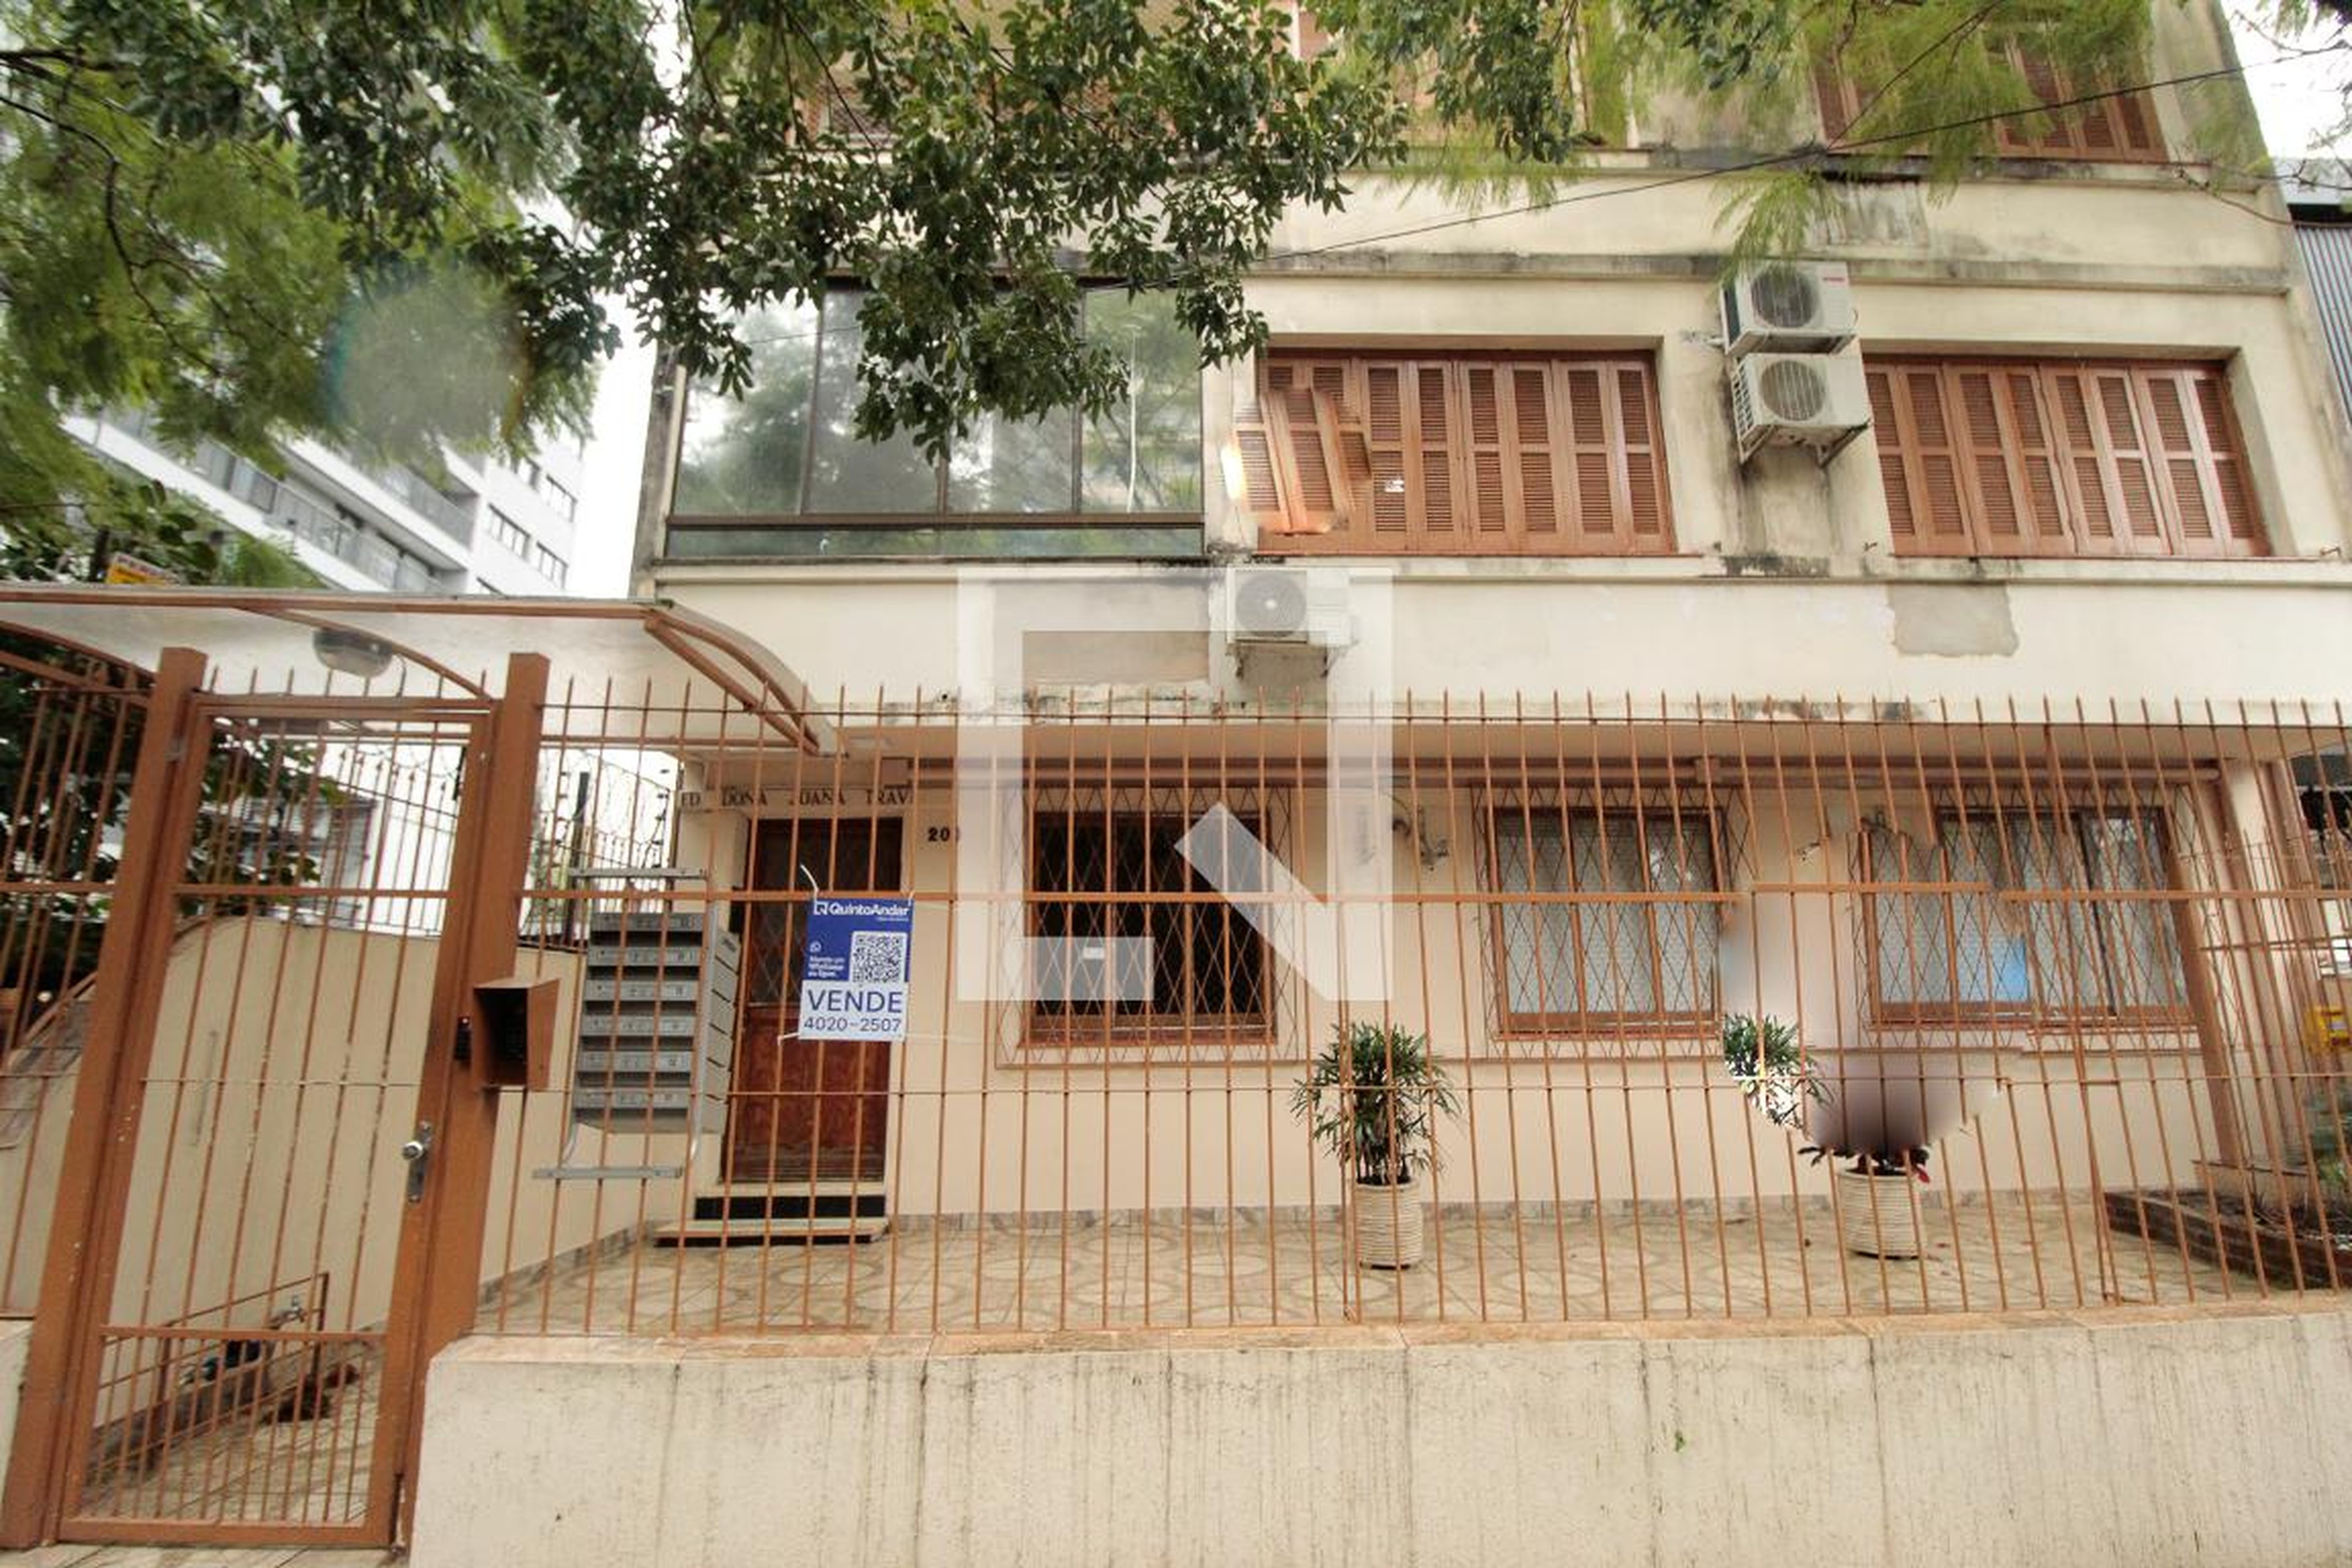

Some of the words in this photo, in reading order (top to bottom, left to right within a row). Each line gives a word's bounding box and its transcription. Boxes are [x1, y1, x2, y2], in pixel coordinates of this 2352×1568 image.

[789, 788, 846, 805] UANA
[829, 902, 909, 916] QuintoAndar
[808, 989, 903, 1013] VENDE
[804, 1016, 902, 1032] 4020-2507
